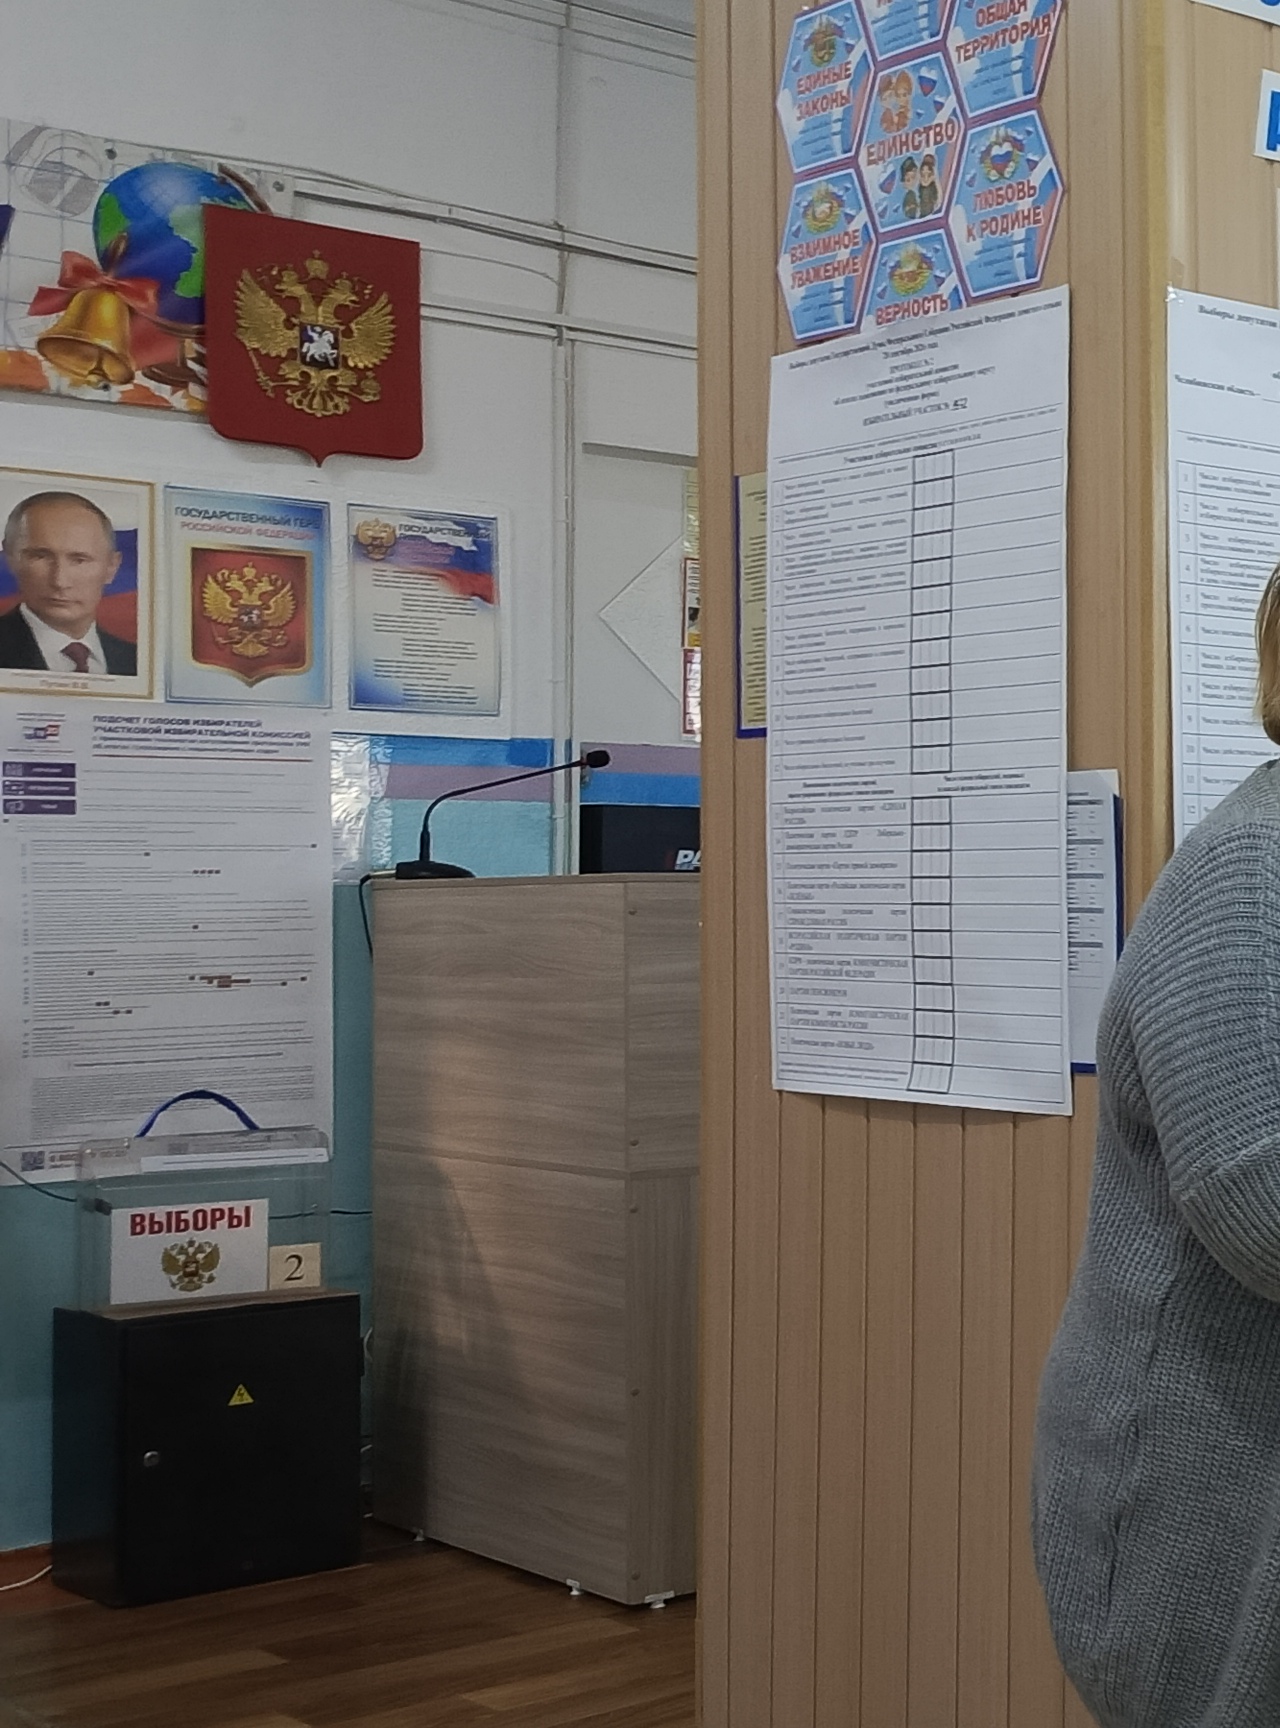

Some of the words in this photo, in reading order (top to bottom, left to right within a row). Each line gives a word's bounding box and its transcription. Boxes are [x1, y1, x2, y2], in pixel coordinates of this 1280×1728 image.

[955, 14, 1051, 63] ТЕРРИТОРИЯ
[797, 62, 852, 95] ЕДИНЫЕ
[796, 92, 852, 121] ЗАКОНЫ
[866, 121, 957, 165] ЕДИНСТВО
[973, 180, 1037, 213] ЛЮБОВЬ
[980, 205, 1044, 237] РОДИНЕ
[790, 229, 861, 264] ВЗАИМНОЕ
[791, 257, 861, 289] УВАЖЕНИЕ
[876, 293, 949, 326] ВЕРНОСТЬ
[130, 1205, 253, 1237] ВЫБОРЫ
[284, 1254, 305, 1283] 2
